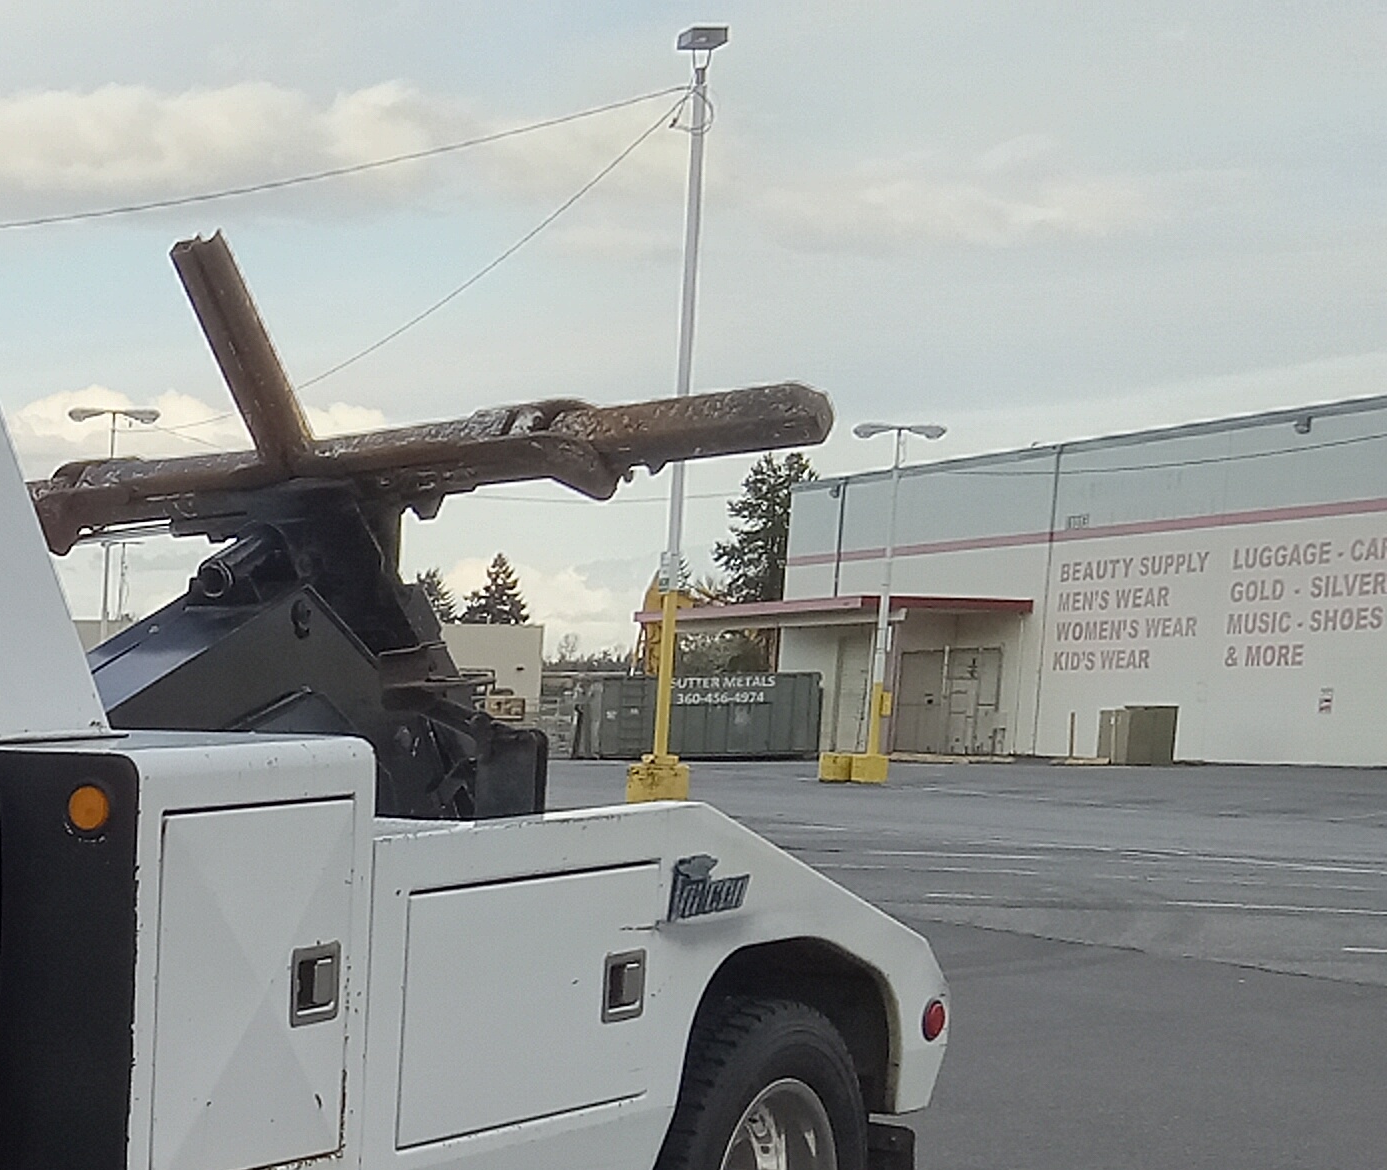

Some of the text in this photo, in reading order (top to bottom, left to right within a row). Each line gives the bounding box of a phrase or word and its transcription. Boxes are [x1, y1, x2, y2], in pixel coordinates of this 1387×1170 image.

[1060, 551, 1210, 582] BEAUTY SUPPLY
[1233, 542, 1332, 570] LUGGAGE
[1057, 586, 1170, 612] MEN'S WEAR
[1230, 579, 1285, 602] GOLD
[1310, 572, 1387, 598] SILVER
[1056, 617, 1198, 642] WOMEN'S WEAR
[1226, 611, 1292, 634] MUSIC
[1309, 606, 1384, 632] SHOES
[1052, 650, 1150, 671] KID'S WEAR
[1225, 644, 1304, 667] & MORE
[723, 675, 776, 687] METALS
[676, 691, 765, 704] 360-456-4974
